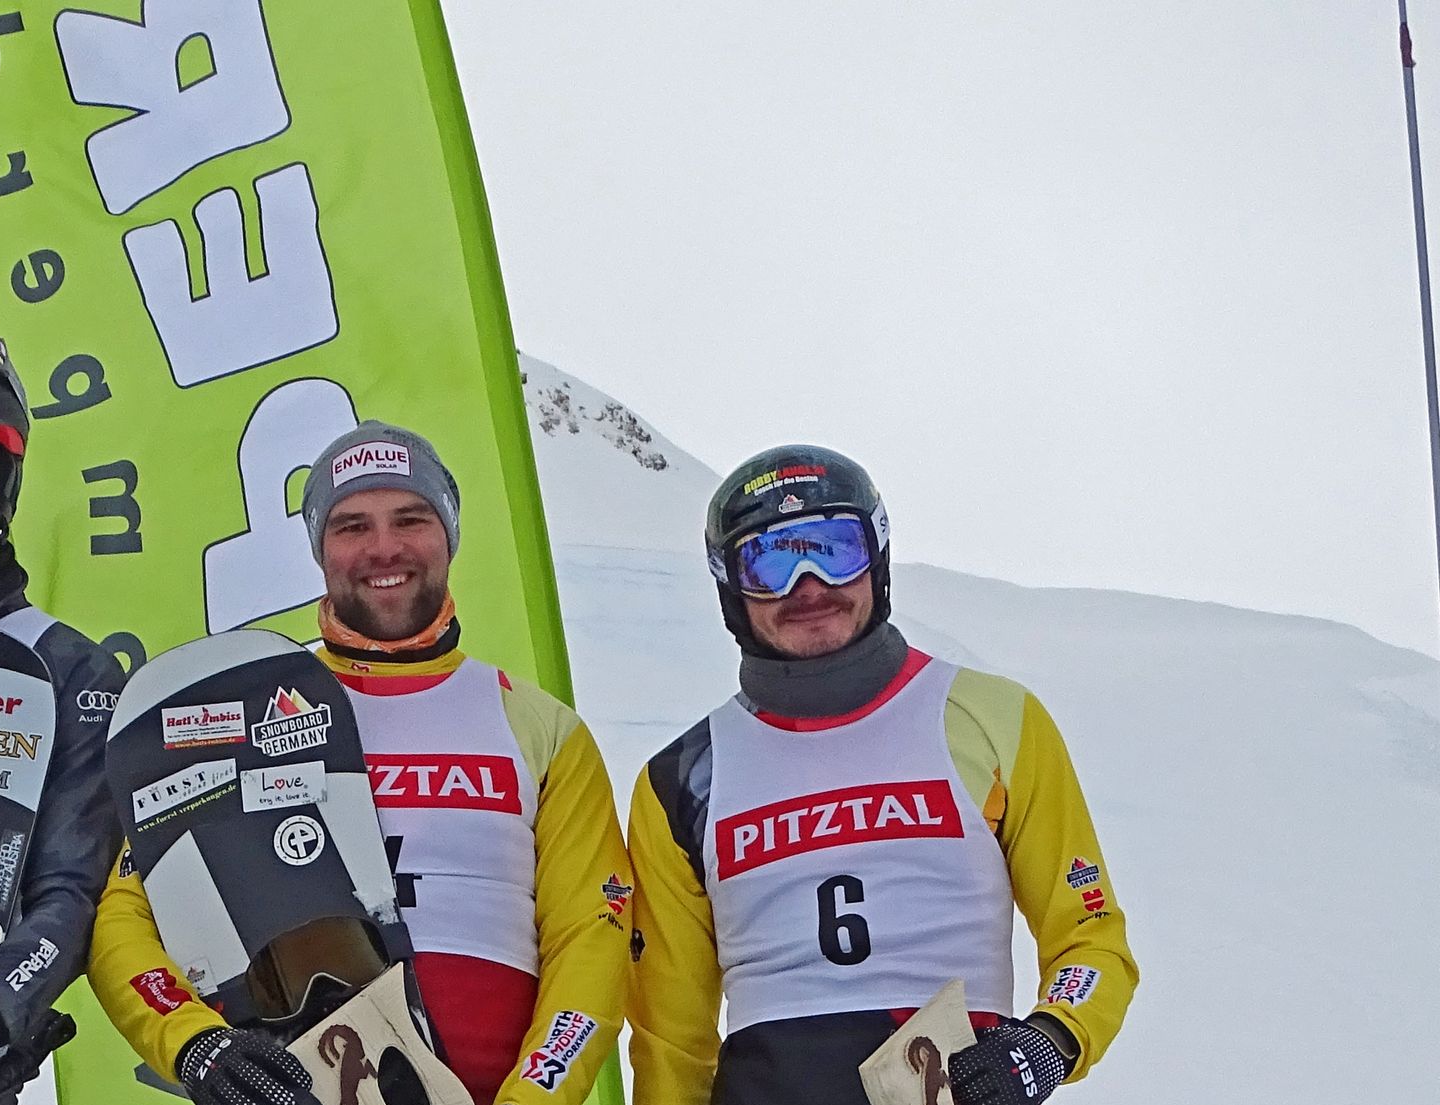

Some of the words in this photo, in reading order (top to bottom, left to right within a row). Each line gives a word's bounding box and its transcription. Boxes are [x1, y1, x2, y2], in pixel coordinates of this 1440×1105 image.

[334, 448, 408, 474] ENVALUE
[78, 715, 103, 723] Audi
[260, 712, 323, 739] SNOWBOARD
[264, 727, 327, 755] GERMANY
[136, 770, 206, 810] FÜRST
[366, 764, 507, 801] ZTAL
[733, 793, 942, 862] PITZTAL
[816, 875, 872, 966] 6
[18, 936, 57, 978] Rehall
[196, 1037, 233, 1080] SEIZ
[561, 1021, 595, 1063] WORKWEAR
[1009, 1046, 1038, 1098] SEIZ
